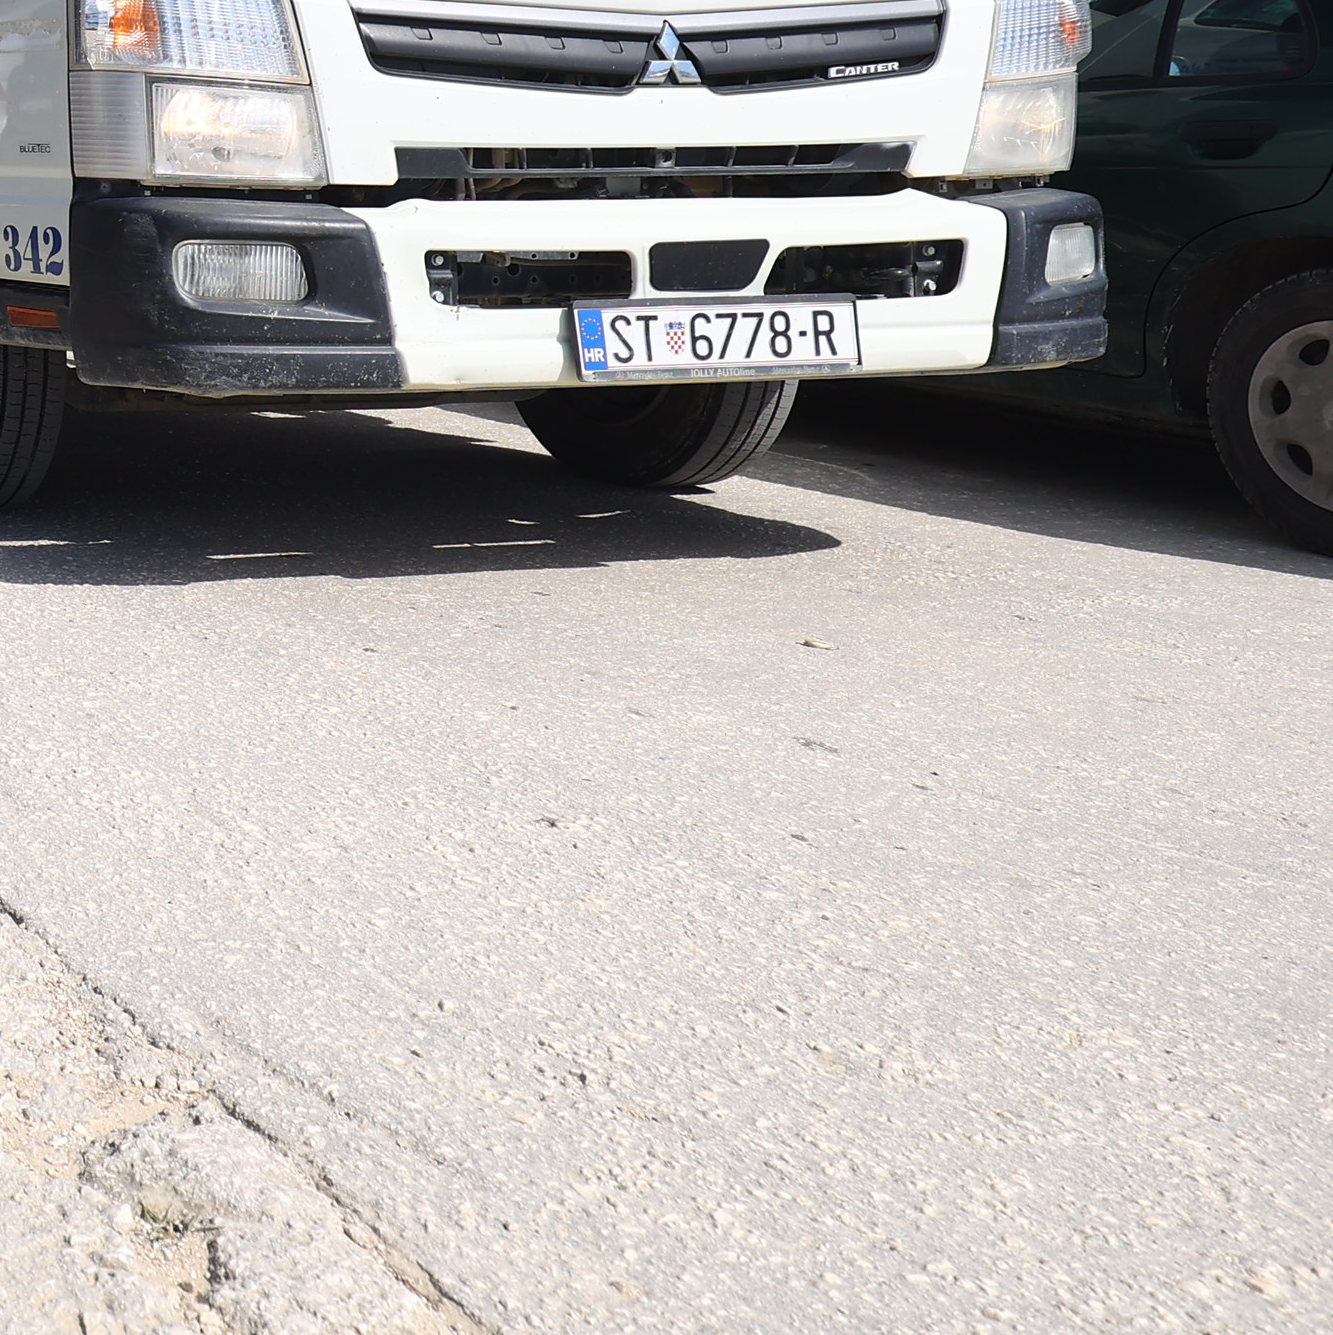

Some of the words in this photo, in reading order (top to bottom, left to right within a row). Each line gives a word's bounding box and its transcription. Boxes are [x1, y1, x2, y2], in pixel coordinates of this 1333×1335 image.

[3, 224, 64, 277] 342
[583, 348, 606, 363] HR
[609, 314, 658, 364] ST
[689, 309, 838, 361] 6778-R
